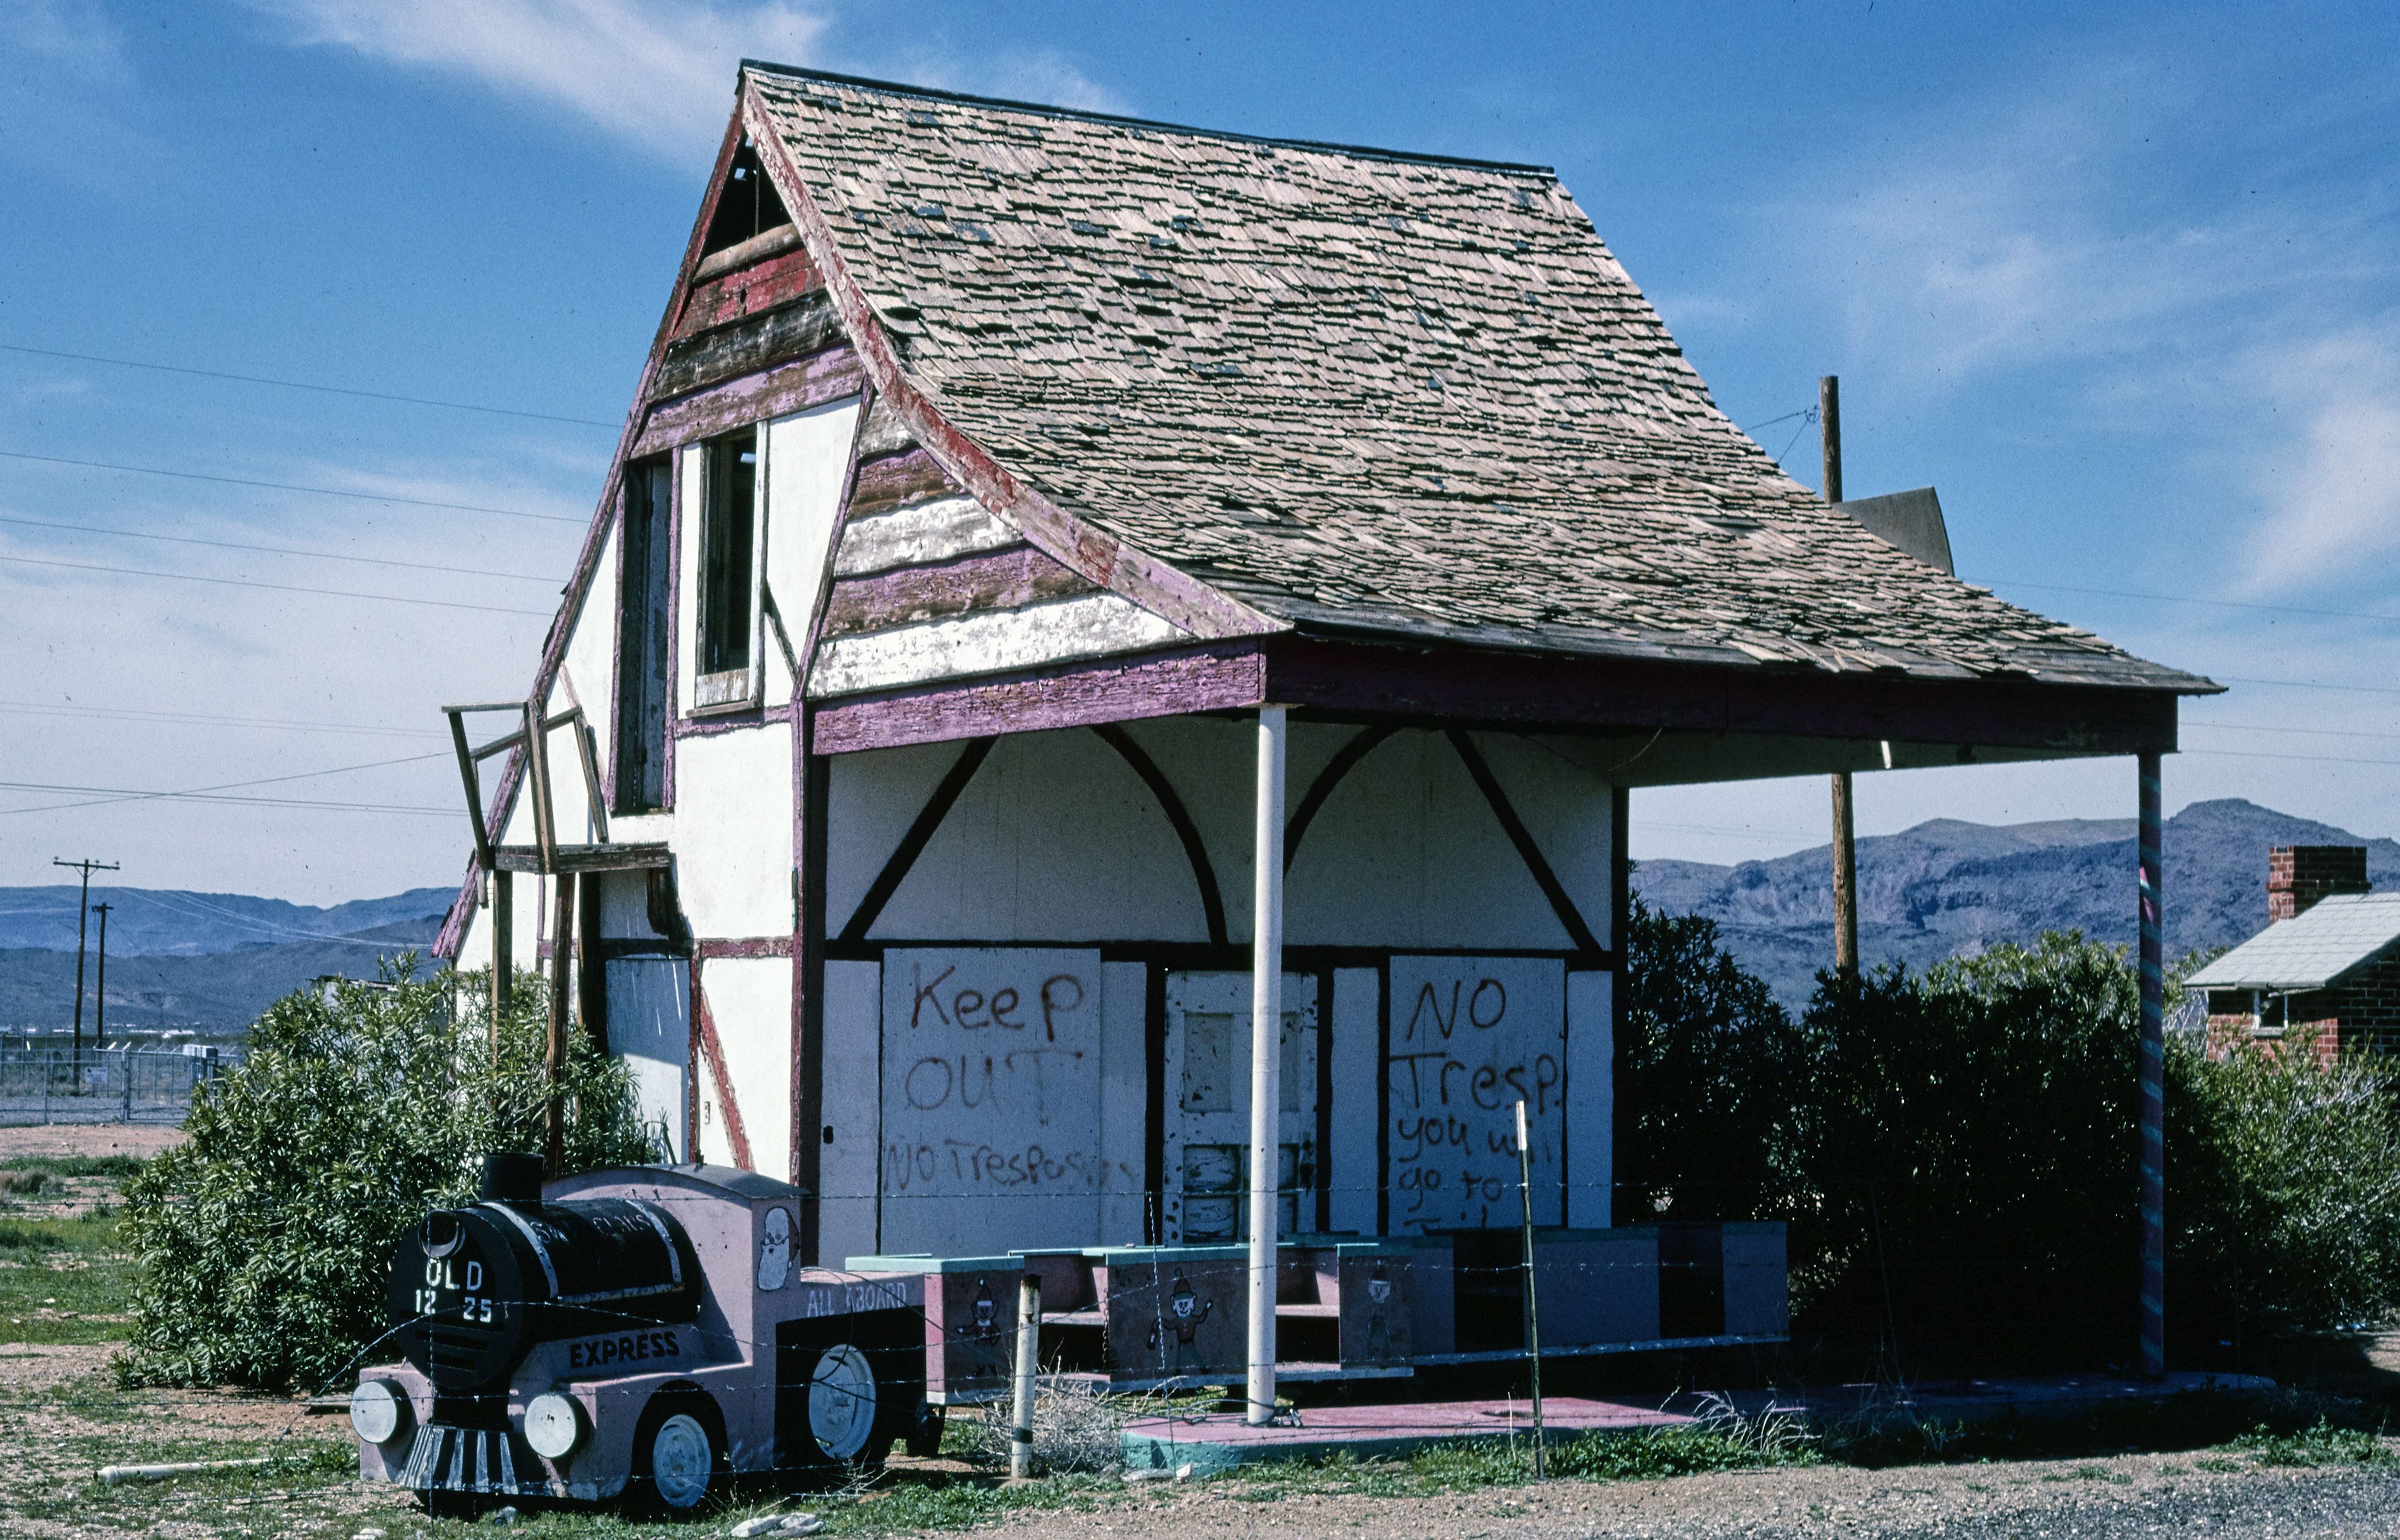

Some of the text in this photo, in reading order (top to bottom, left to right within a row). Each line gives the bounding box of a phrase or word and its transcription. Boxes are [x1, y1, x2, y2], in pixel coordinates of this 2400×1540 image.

[1407, 978, 1506, 1041] NO
[906, 1049, 1083, 1126] OUT
[1398, 1115, 1472, 1163] you
[883, 1145, 934, 1191] NO
[1399, 1168, 1503, 1212] go to
[426, 1258, 482, 1291] OLD
[416, 1289, 492, 1323] 12 25
[807, 1282, 907, 1318] ALL ABOARD
[570, 1331, 680, 1369] EXPRESS
